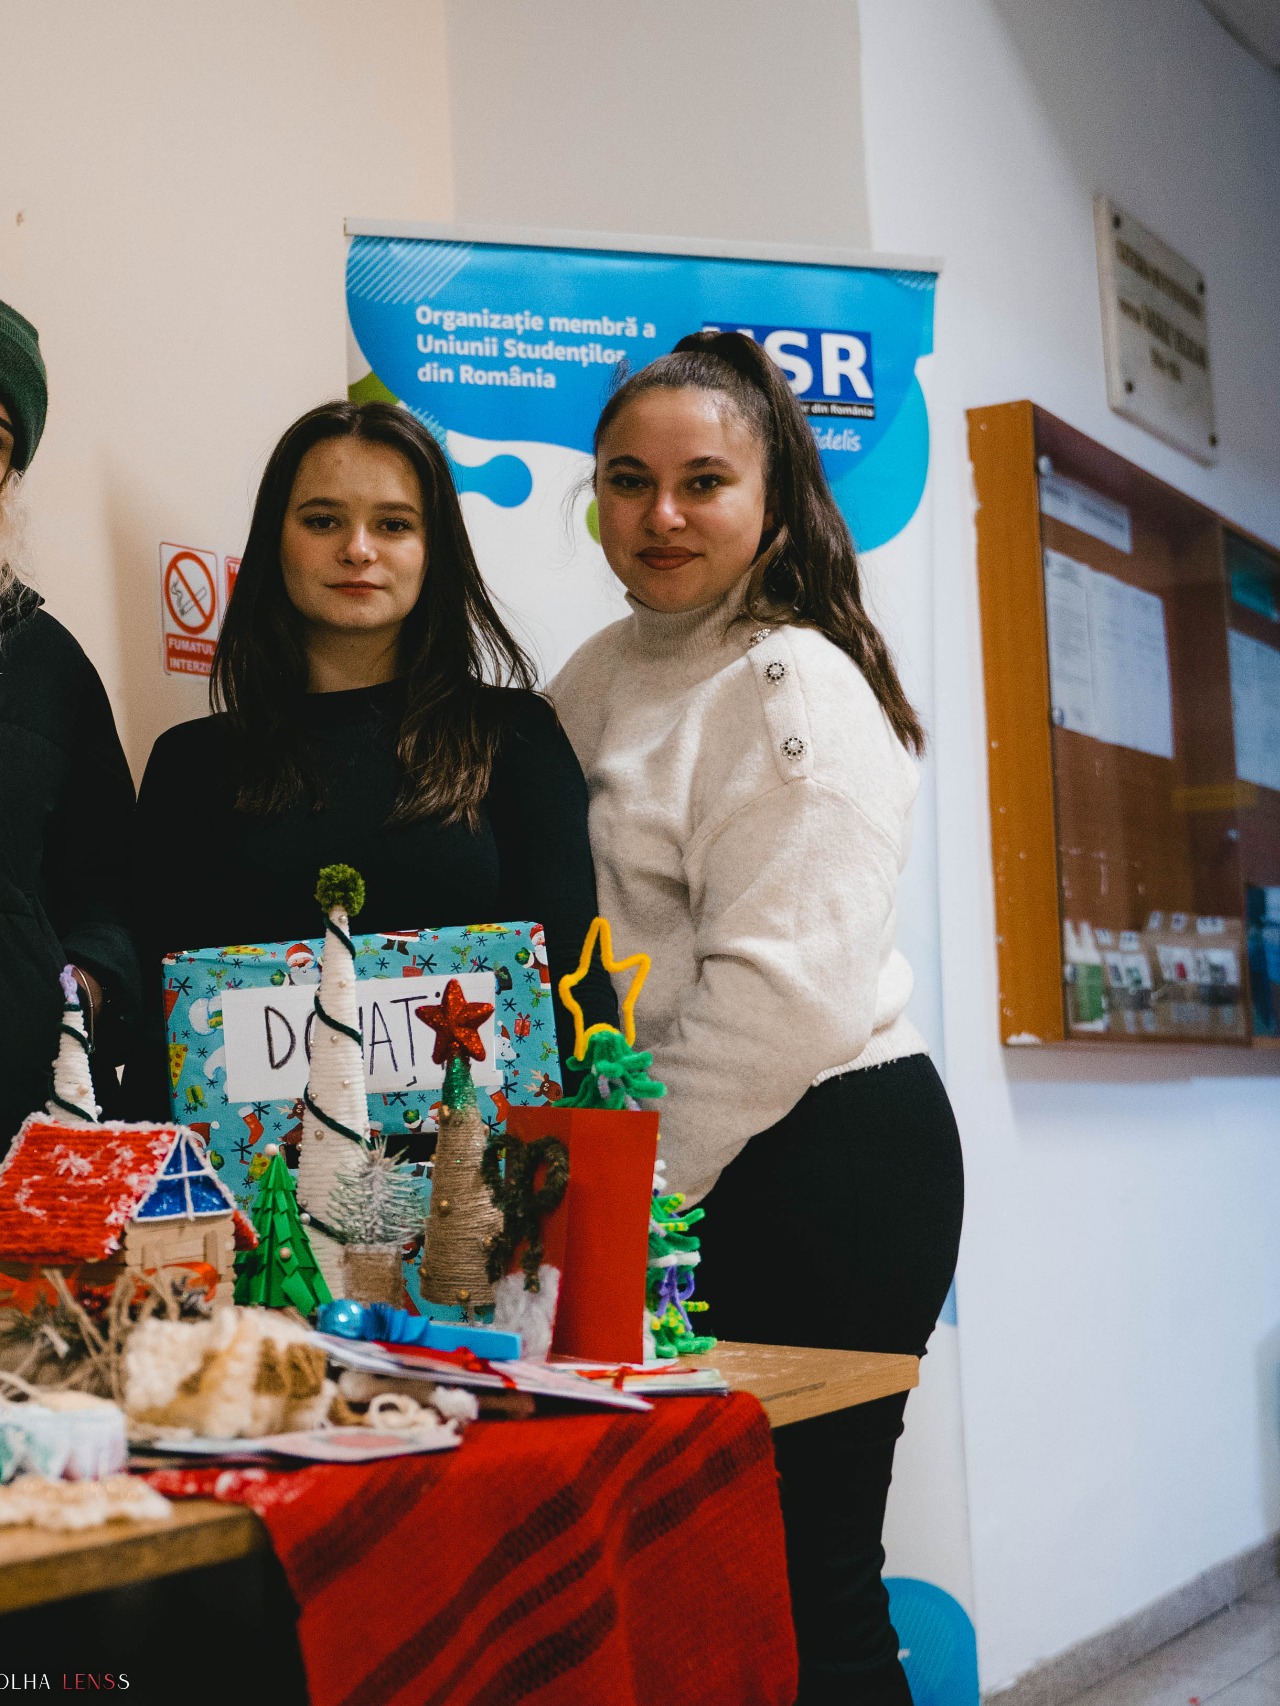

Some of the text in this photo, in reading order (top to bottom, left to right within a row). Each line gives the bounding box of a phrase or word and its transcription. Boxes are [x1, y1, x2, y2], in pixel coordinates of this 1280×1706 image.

[415, 305, 657, 339] Organizație membră a
[416, 334, 627, 368] Uniunii Studenților
[702, 325, 874, 400] SR
[417, 362, 557, 389] din România
